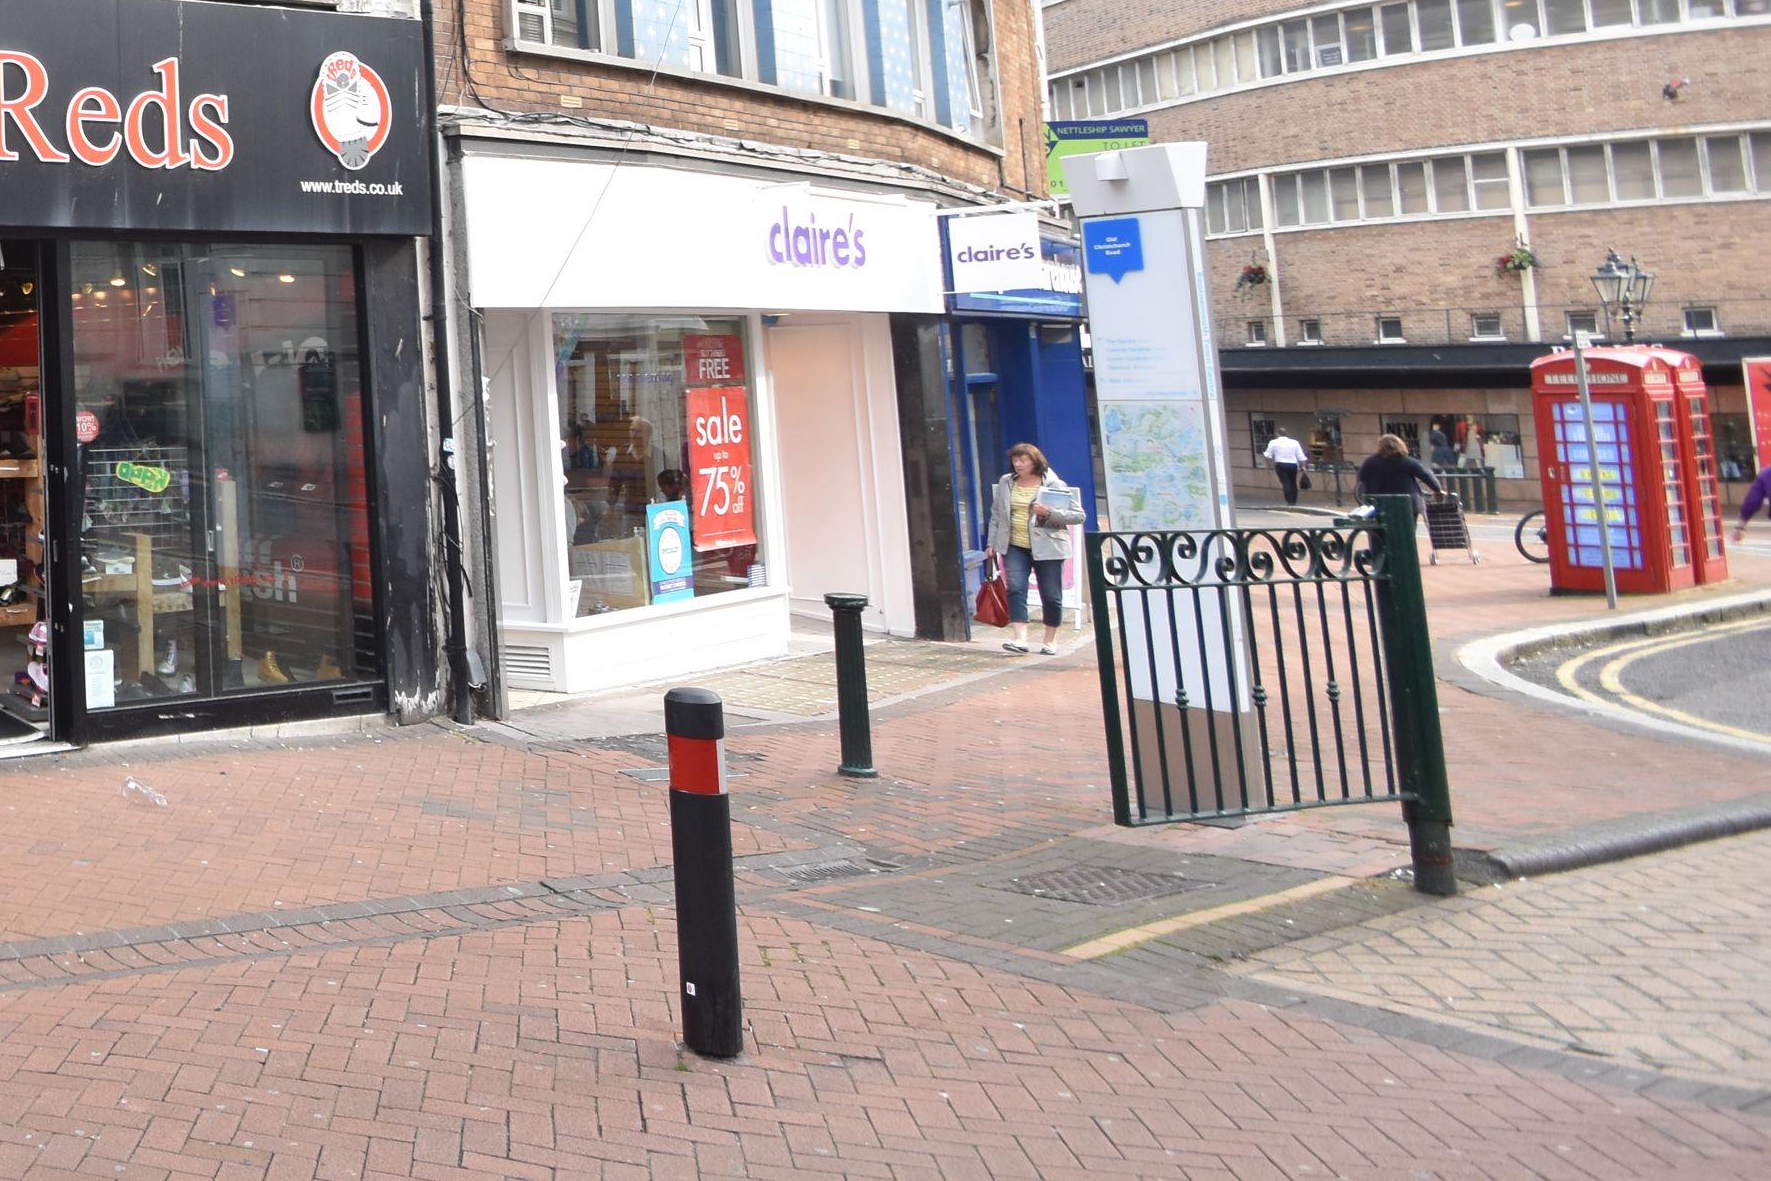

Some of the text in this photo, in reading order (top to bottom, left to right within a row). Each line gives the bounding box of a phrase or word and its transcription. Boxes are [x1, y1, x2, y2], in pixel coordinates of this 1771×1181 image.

[326, 59, 357, 82] tReds
[1057, 124, 1145, 135] NETTLESHIP SAWYER
[1102, 142, 1120, 151] TO
[300, 180, 403, 196] www.treds.co.uk
[769, 205, 867, 267] claire's
[957, 242, 1035, 264] claire's
[699, 358, 731, 380] FREE
[696, 396, 742, 447] sale
[713, 451, 729, 462] up to
[699, 466, 745, 517] 75% off
